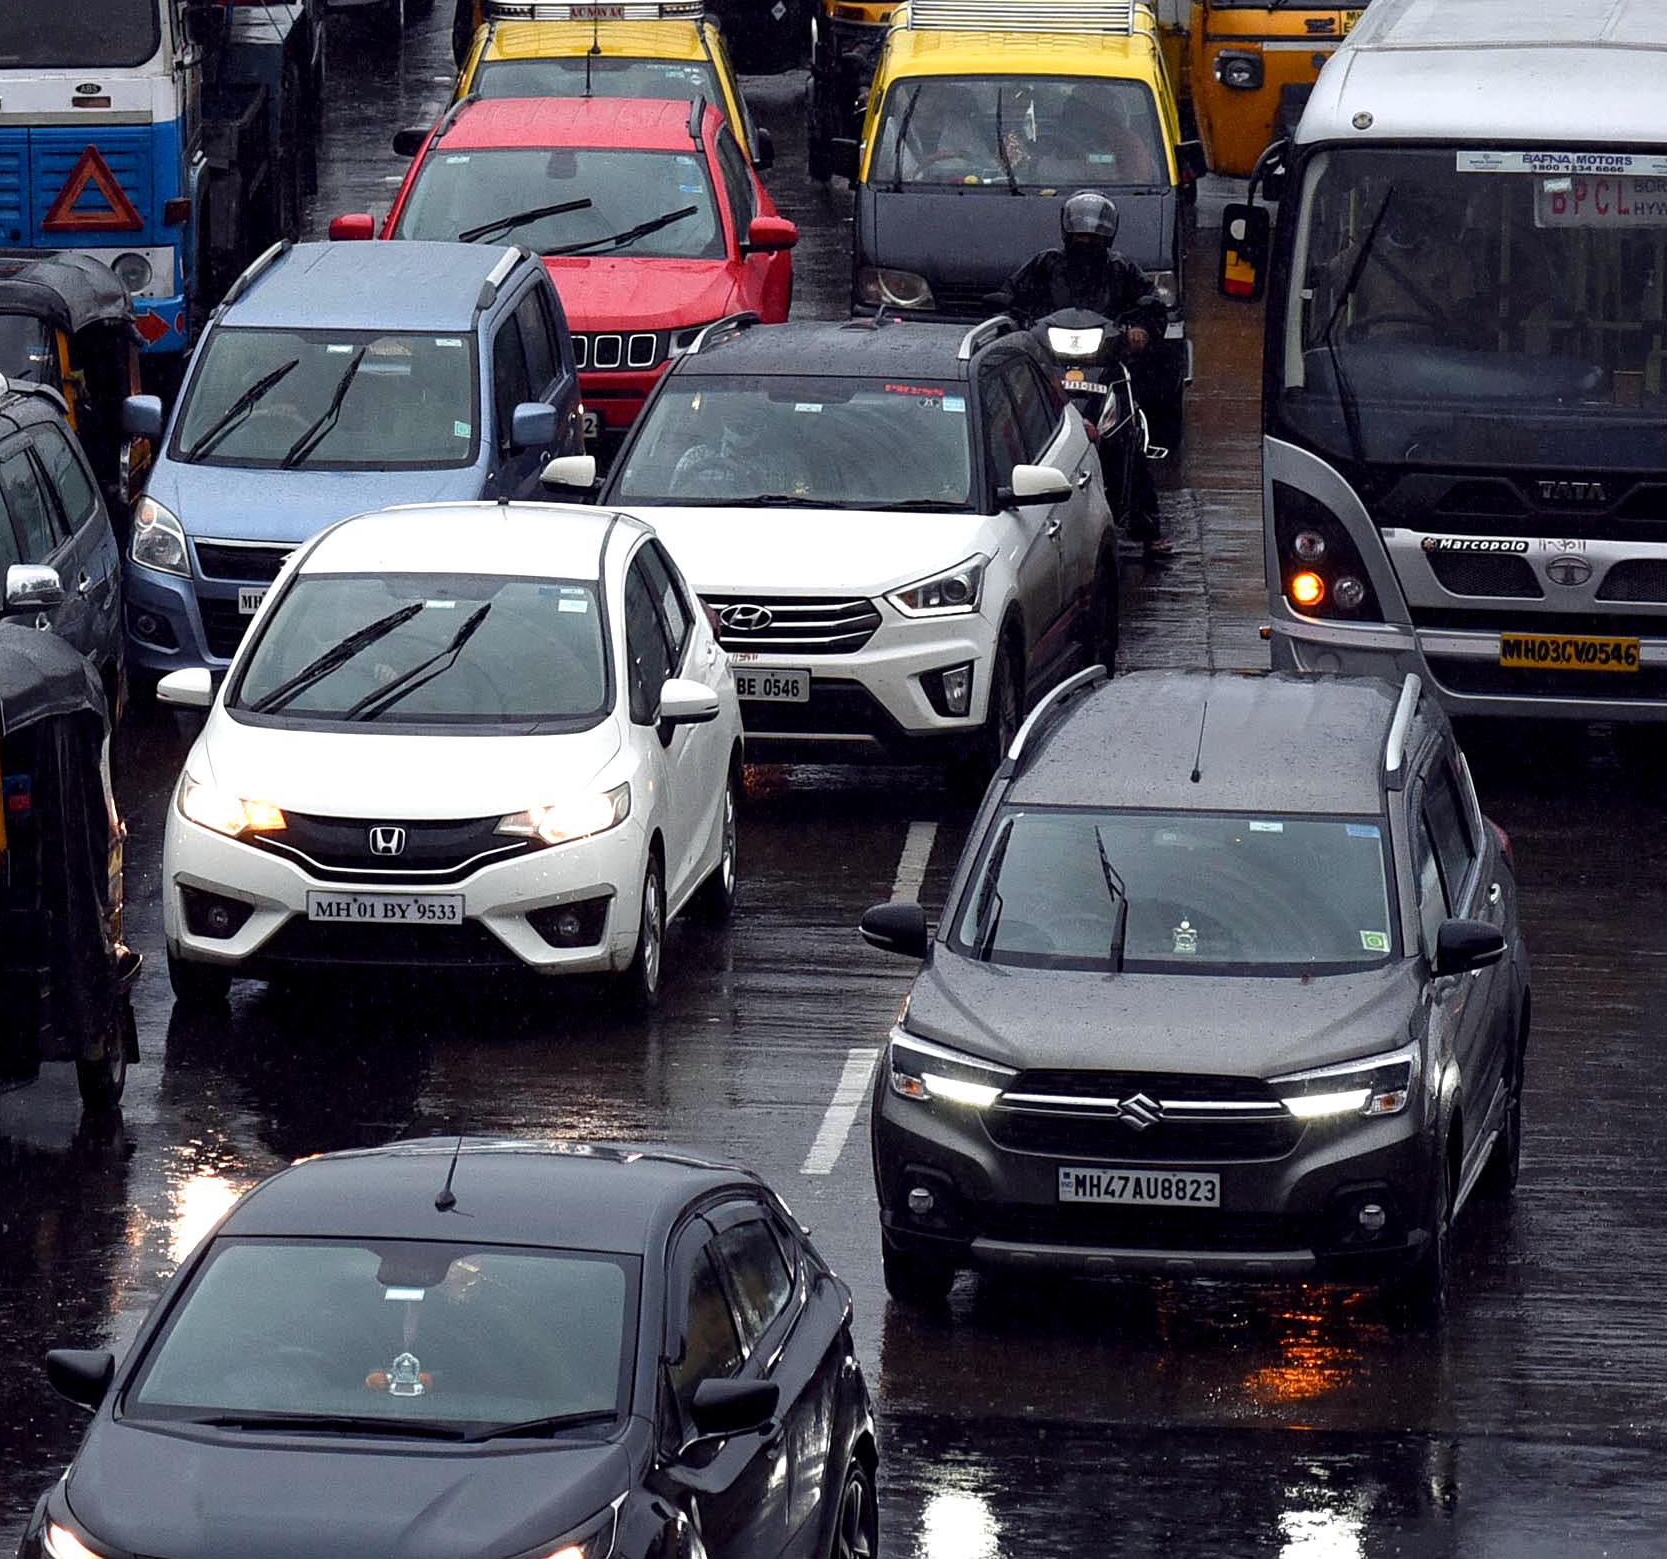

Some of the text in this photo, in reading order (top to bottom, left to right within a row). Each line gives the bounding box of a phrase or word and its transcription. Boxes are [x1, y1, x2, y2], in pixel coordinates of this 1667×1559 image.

[1522, 153, 1634, 168] BAFNA MOTORS
[1530, 163, 1562, 173] 1800
[1563, 164, 1594, 174] 1234
[1539, 480, 1607, 501] TATA
[1439, 539, 1528, 552] Marcopolo
[737, 678, 799, 697] BE 0546
[314, 906, 457, 921] MH 01 BY 9533
[1074, 1174, 1217, 1203] MH47AU8823
